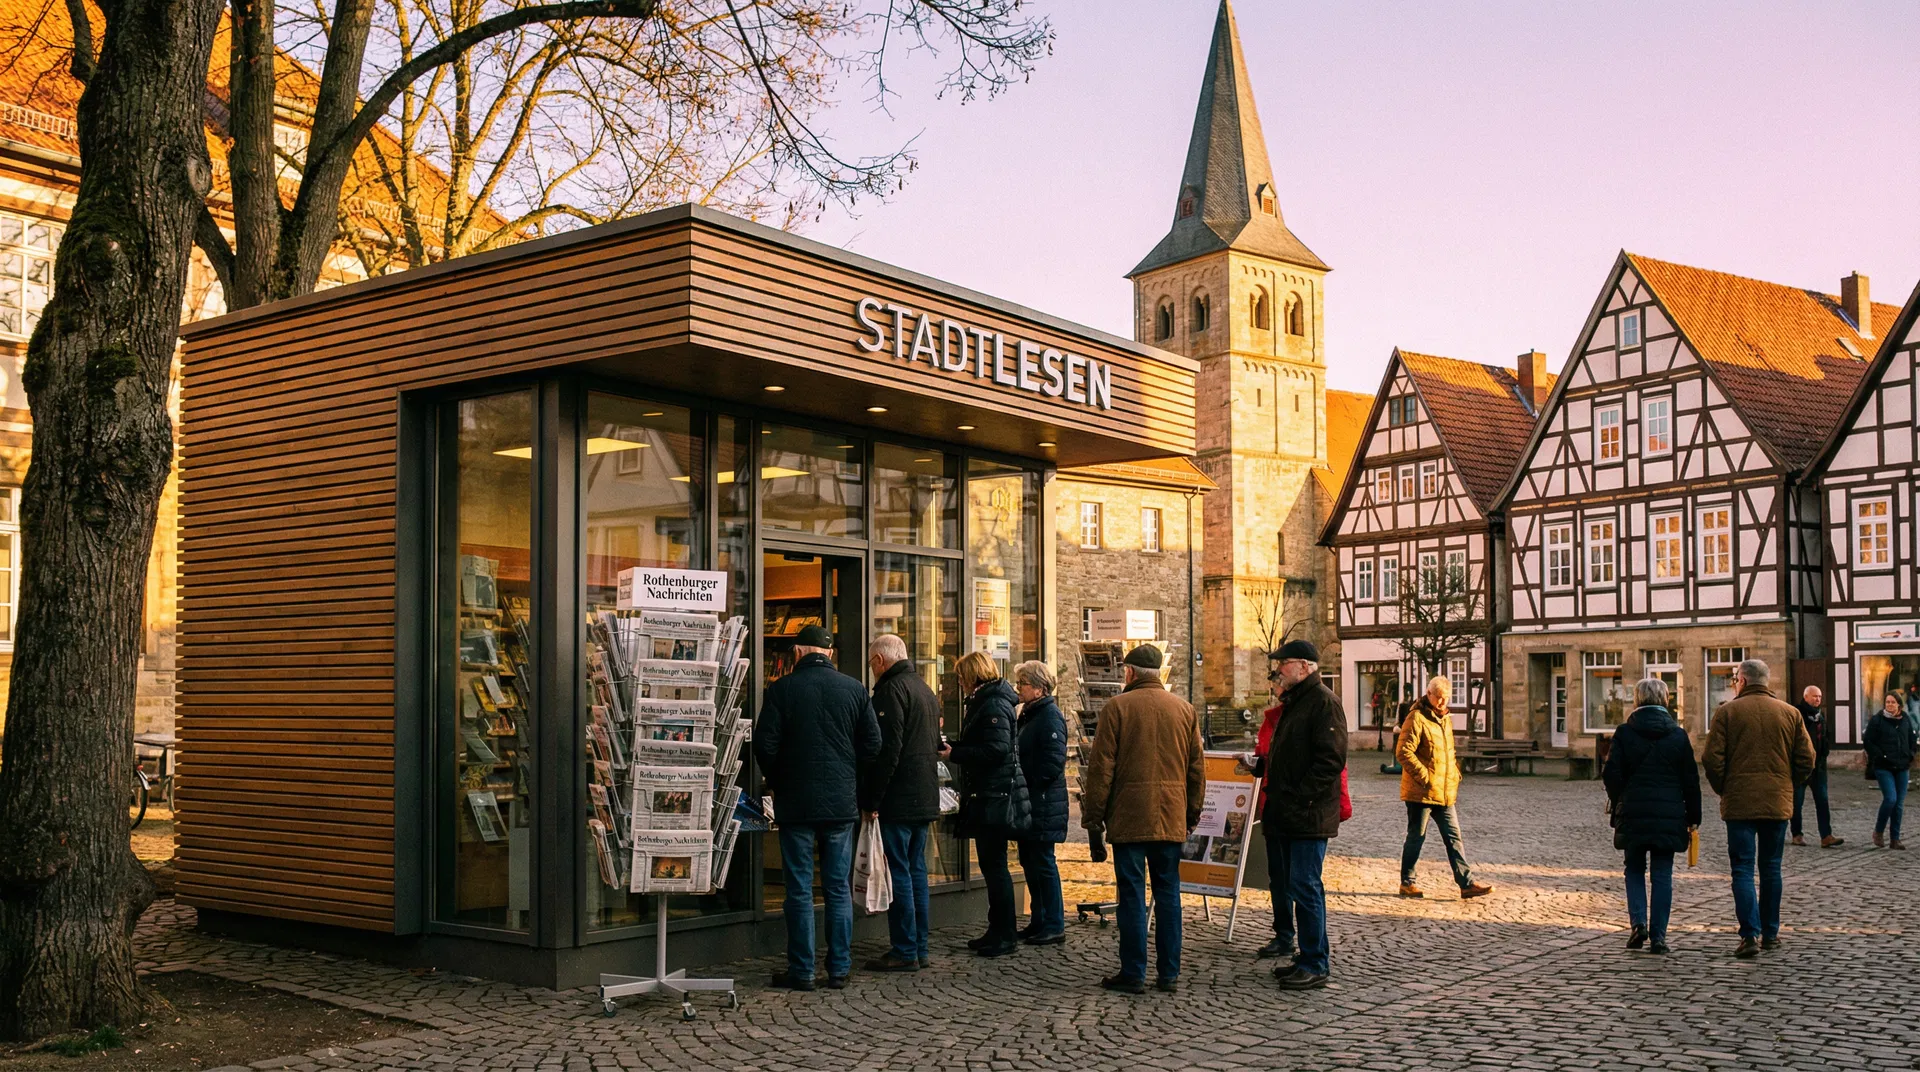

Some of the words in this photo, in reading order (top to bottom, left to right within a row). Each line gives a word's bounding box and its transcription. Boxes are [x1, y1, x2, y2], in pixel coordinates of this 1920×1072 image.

[856, 297, 1111, 410] STADTLESEN
[643, 573, 718, 591] Rothenburger
[647, 587, 713, 601] Nachrichten
